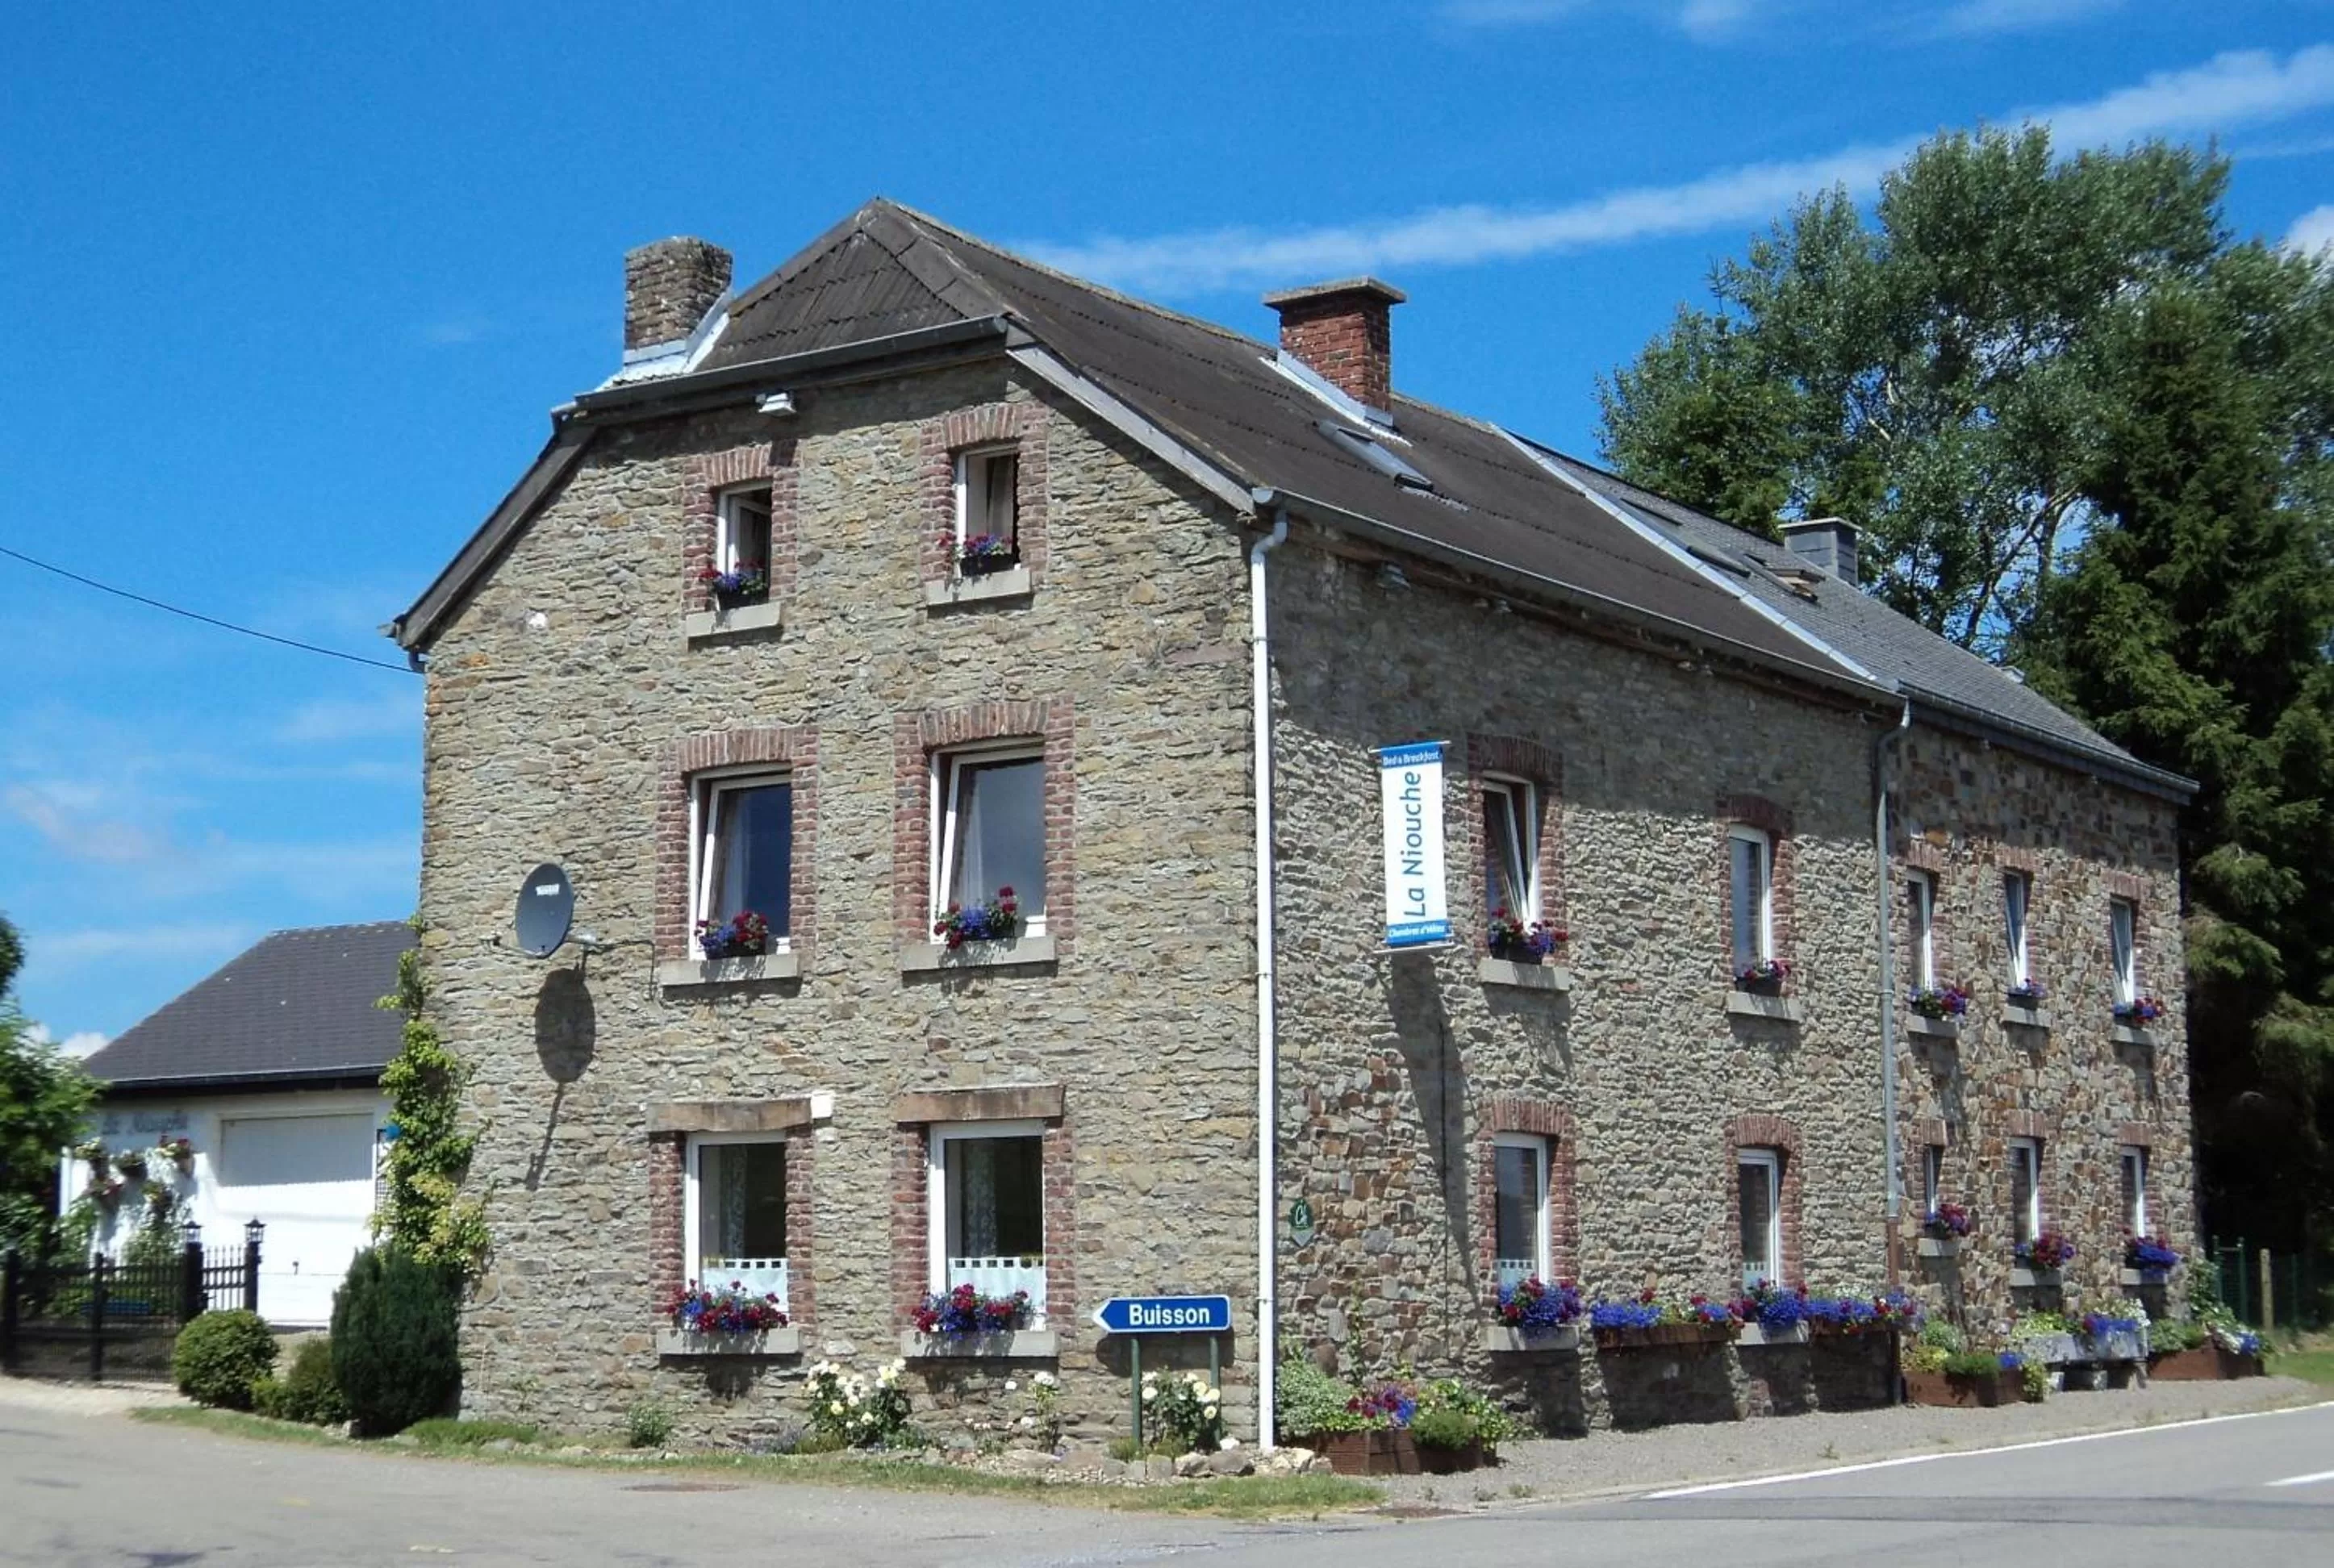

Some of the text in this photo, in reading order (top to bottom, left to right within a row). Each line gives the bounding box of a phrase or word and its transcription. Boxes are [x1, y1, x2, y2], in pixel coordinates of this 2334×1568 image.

[1399, 771, 1423, 875] Niouche
[1404, 886, 1426, 917] La
[1129, 1303, 1210, 1326] Buisson
